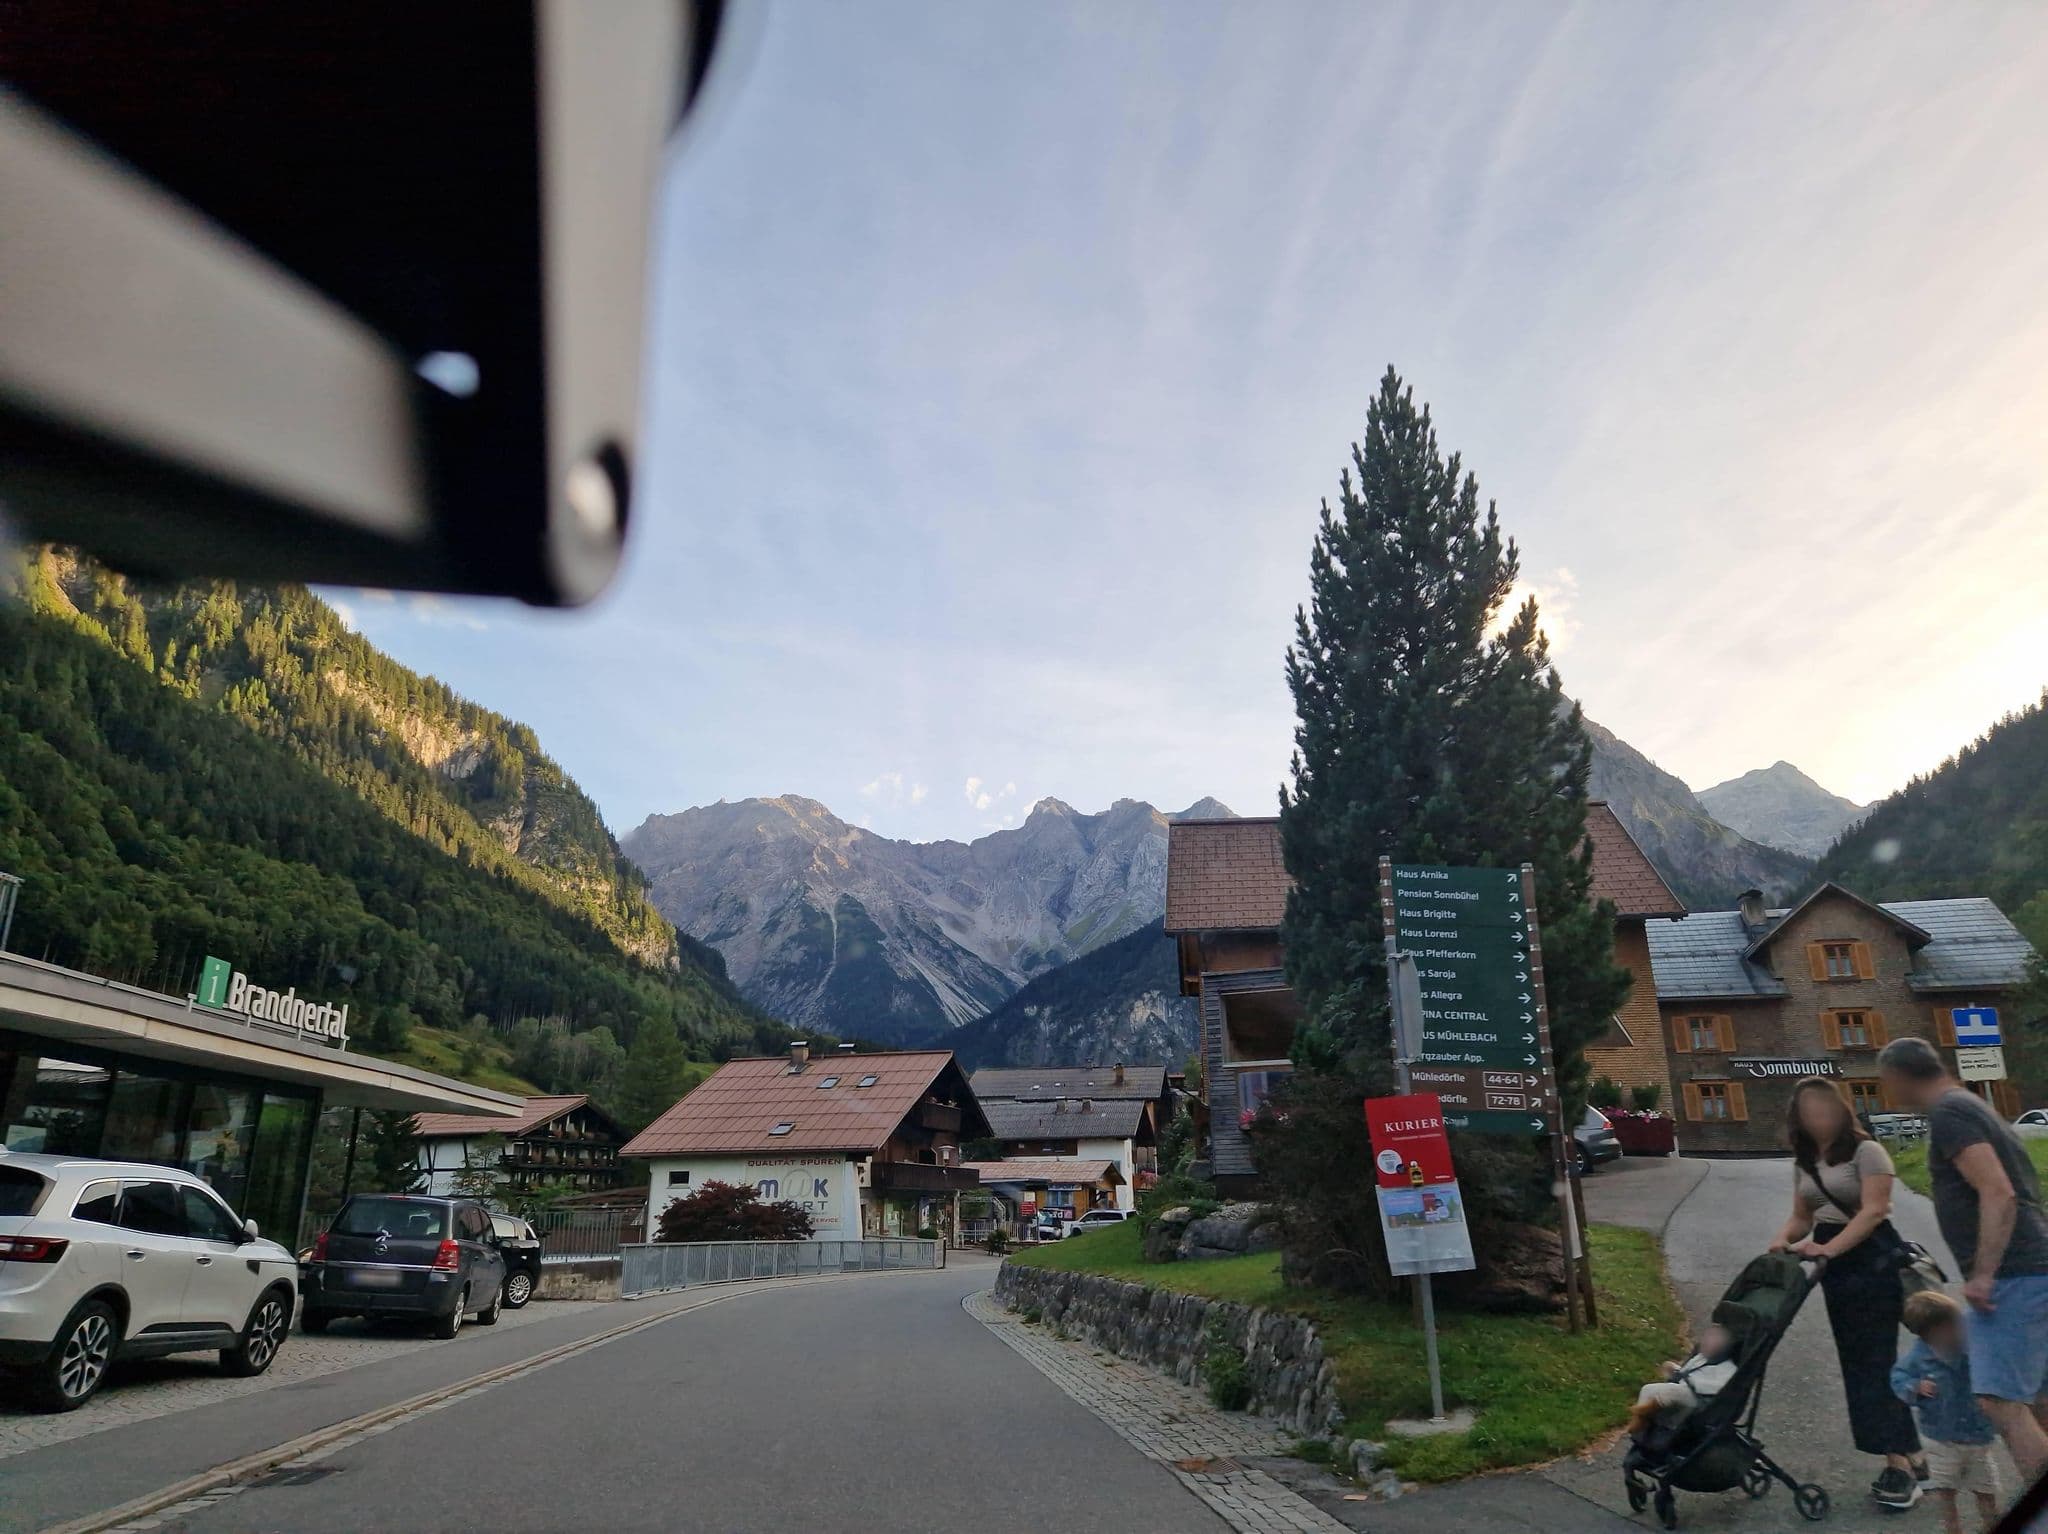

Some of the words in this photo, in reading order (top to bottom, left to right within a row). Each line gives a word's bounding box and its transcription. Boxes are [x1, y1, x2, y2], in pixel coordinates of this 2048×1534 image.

[1396, 870, 1418, 878] Haus
[1421, 871, 1449, 880] Arnika
[1398, 889, 1432, 898] Pension
[1434, 890, 1479, 901] Sonnbühel
[1400, 909, 1421, 917] Haus
[1424, 909, 1457, 920] Brigitte
[1401, 928, 1423, 937] Haus
[1425, 929, 1458, 939] Lorenzi
[1426, 949, 1476, 960] Pfefferkorn
[1428, 969, 1457, 980] Saroja
[1431, 991, 1463, 1001] Allegra
[229, 971, 349, 1040] Brandnertal
[1444, 1011, 1489, 1021] CENTRAL
[1422, 1031, 1435, 1040] US
[1438, 1031, 1498, 1042] MÜHLEBACH
[1464, 1053, 1485, 1063] App.
[1412, 1072, 1466, 1083] Mühledörfle
[1488, 1075, 1519, 1084] 44-64
[1492, 1096, 1521, 1106] 72-78
[1385, 1118, 1439, 1133] KURIER
